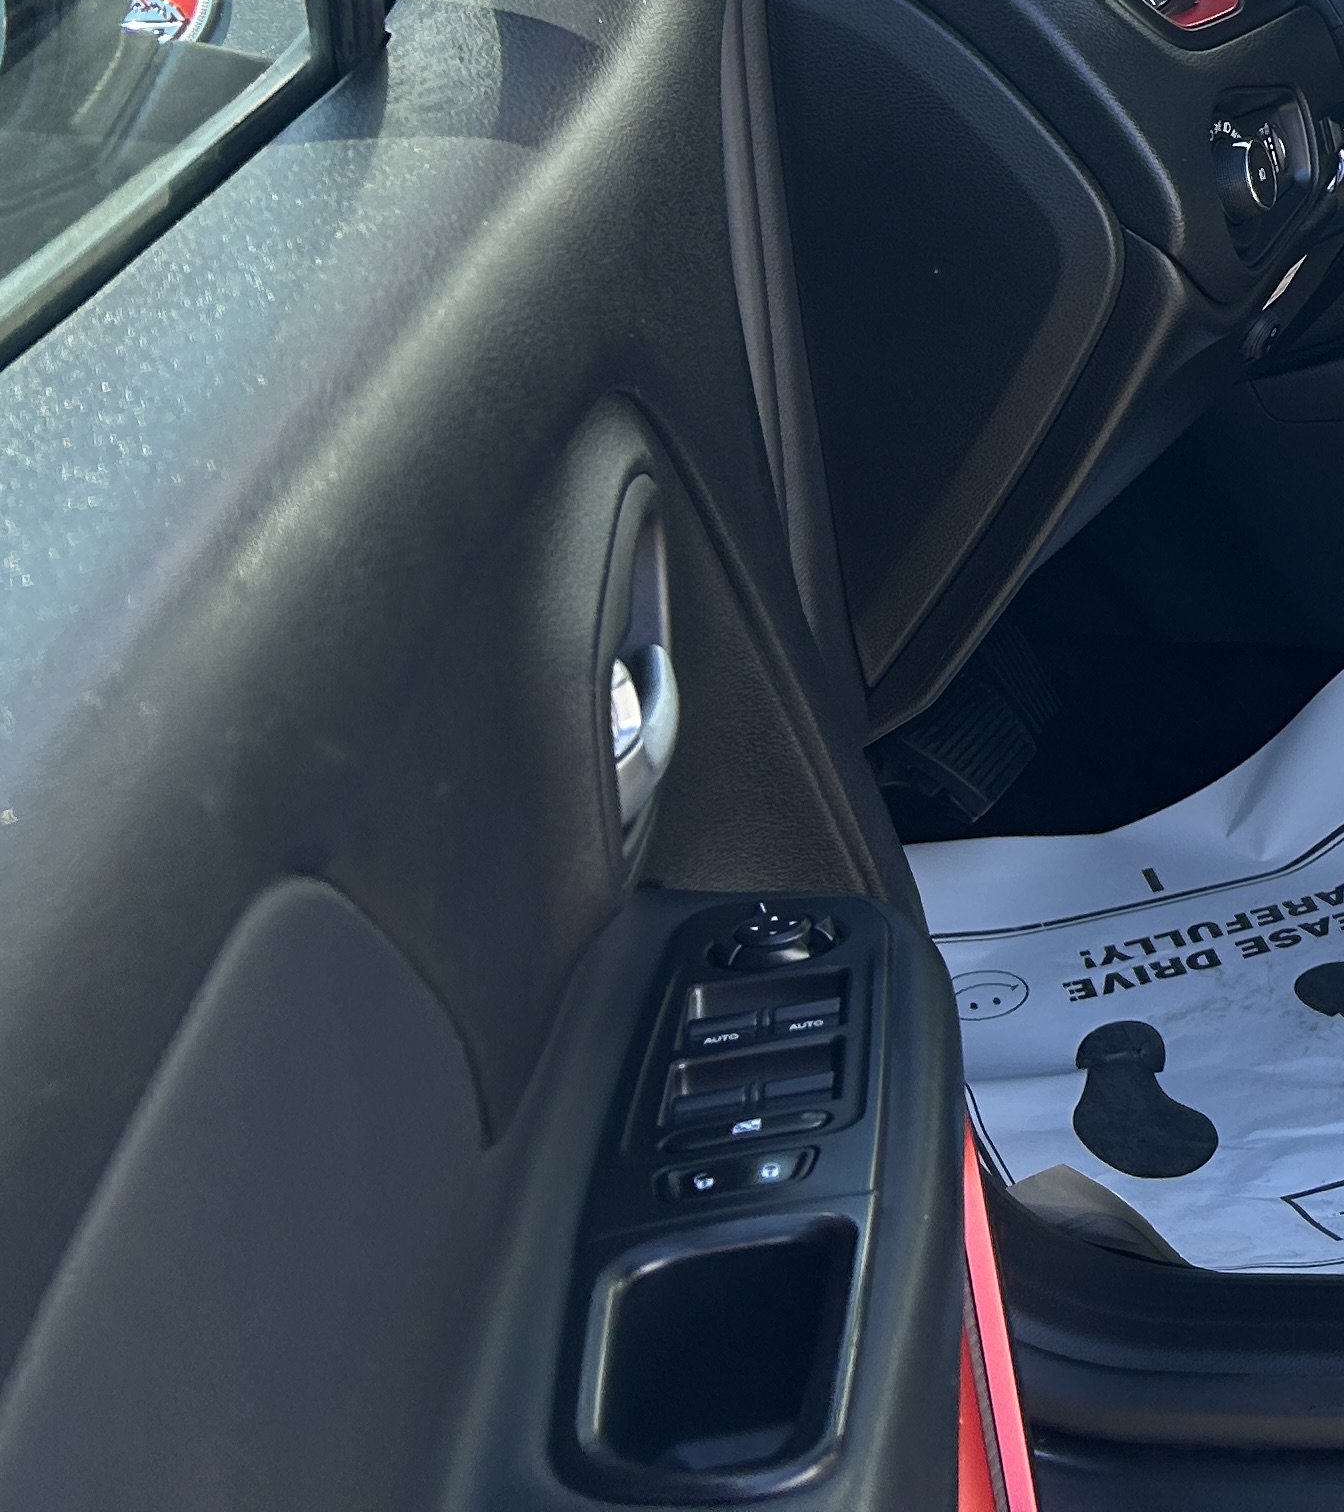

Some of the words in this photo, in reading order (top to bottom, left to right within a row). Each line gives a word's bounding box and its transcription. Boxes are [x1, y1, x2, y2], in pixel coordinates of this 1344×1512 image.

[1062, 947, 1222, 1002] DRIVE
[789, 1019, 824, 1031] AUTO
[704, 1032, 739, 1045] AUTO
